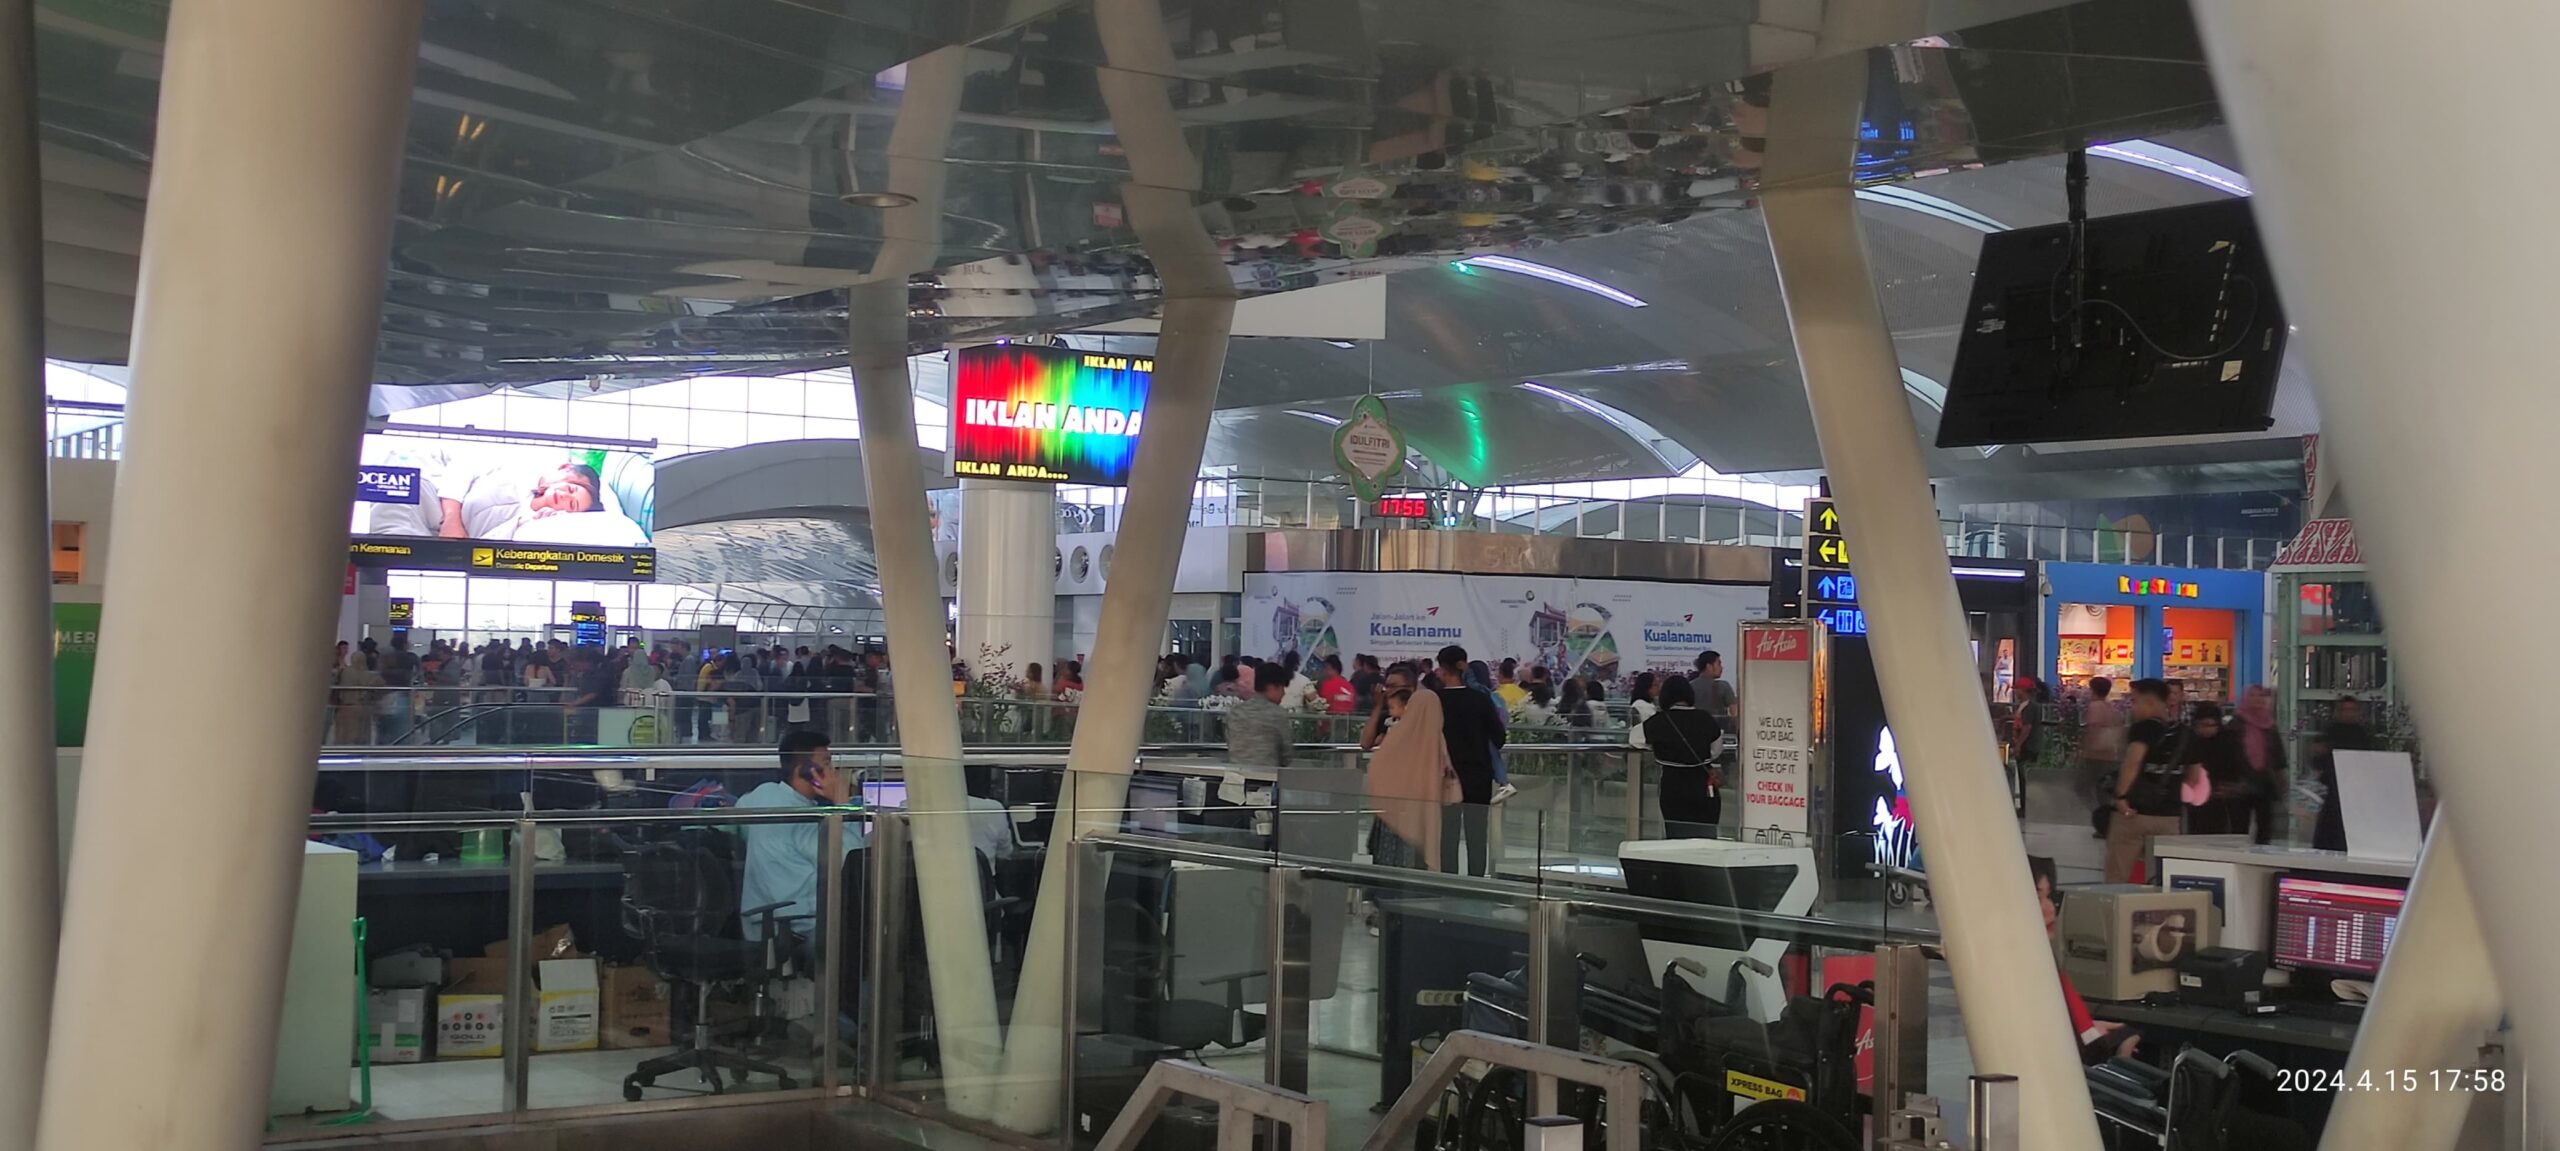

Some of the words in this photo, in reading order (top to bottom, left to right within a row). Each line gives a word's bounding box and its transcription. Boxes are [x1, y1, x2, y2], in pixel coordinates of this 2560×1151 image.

[1084, 355, 1127, 370] IKLAN
[1132, 357, 1153, 373] AN
[965, 398, 1058, 430] IKLAN
[1062, 406, 1143, 437] ANDA
[955, 460, 1001, 476] IKLAN
[496, 548, 574, 562] Keberangkatan
[577, 551, 625, 563] Domestik
[1370, 622, 1462, 638] Kualanamu
[1644, 629, 1712, 643] Kualanamu
[1759, 717, 1771, 726] WE
[1772, 718, 1793, 728] LOVE
[1756, 731, 1776, 740] YOUR
[1753, 748, 1766, 759] LET
[1768, 750, 1777, 759] US
[1780, 750, 1799, 761] TAKE
[1755, 762, 1774, 773] CARE
[1776, 763, 1786, 774] OF
[1757, 781, 1782, 792] CHECK
[1785, 783, 1794, 793] IN
[1746, 793, 1766, 804] YOUR
[1768, 795, 1805, 808] BAGGAGE
[1730, 1077, 1763, 1094] XPRESS
[1765, 1087, 1783, 1098] BAG
